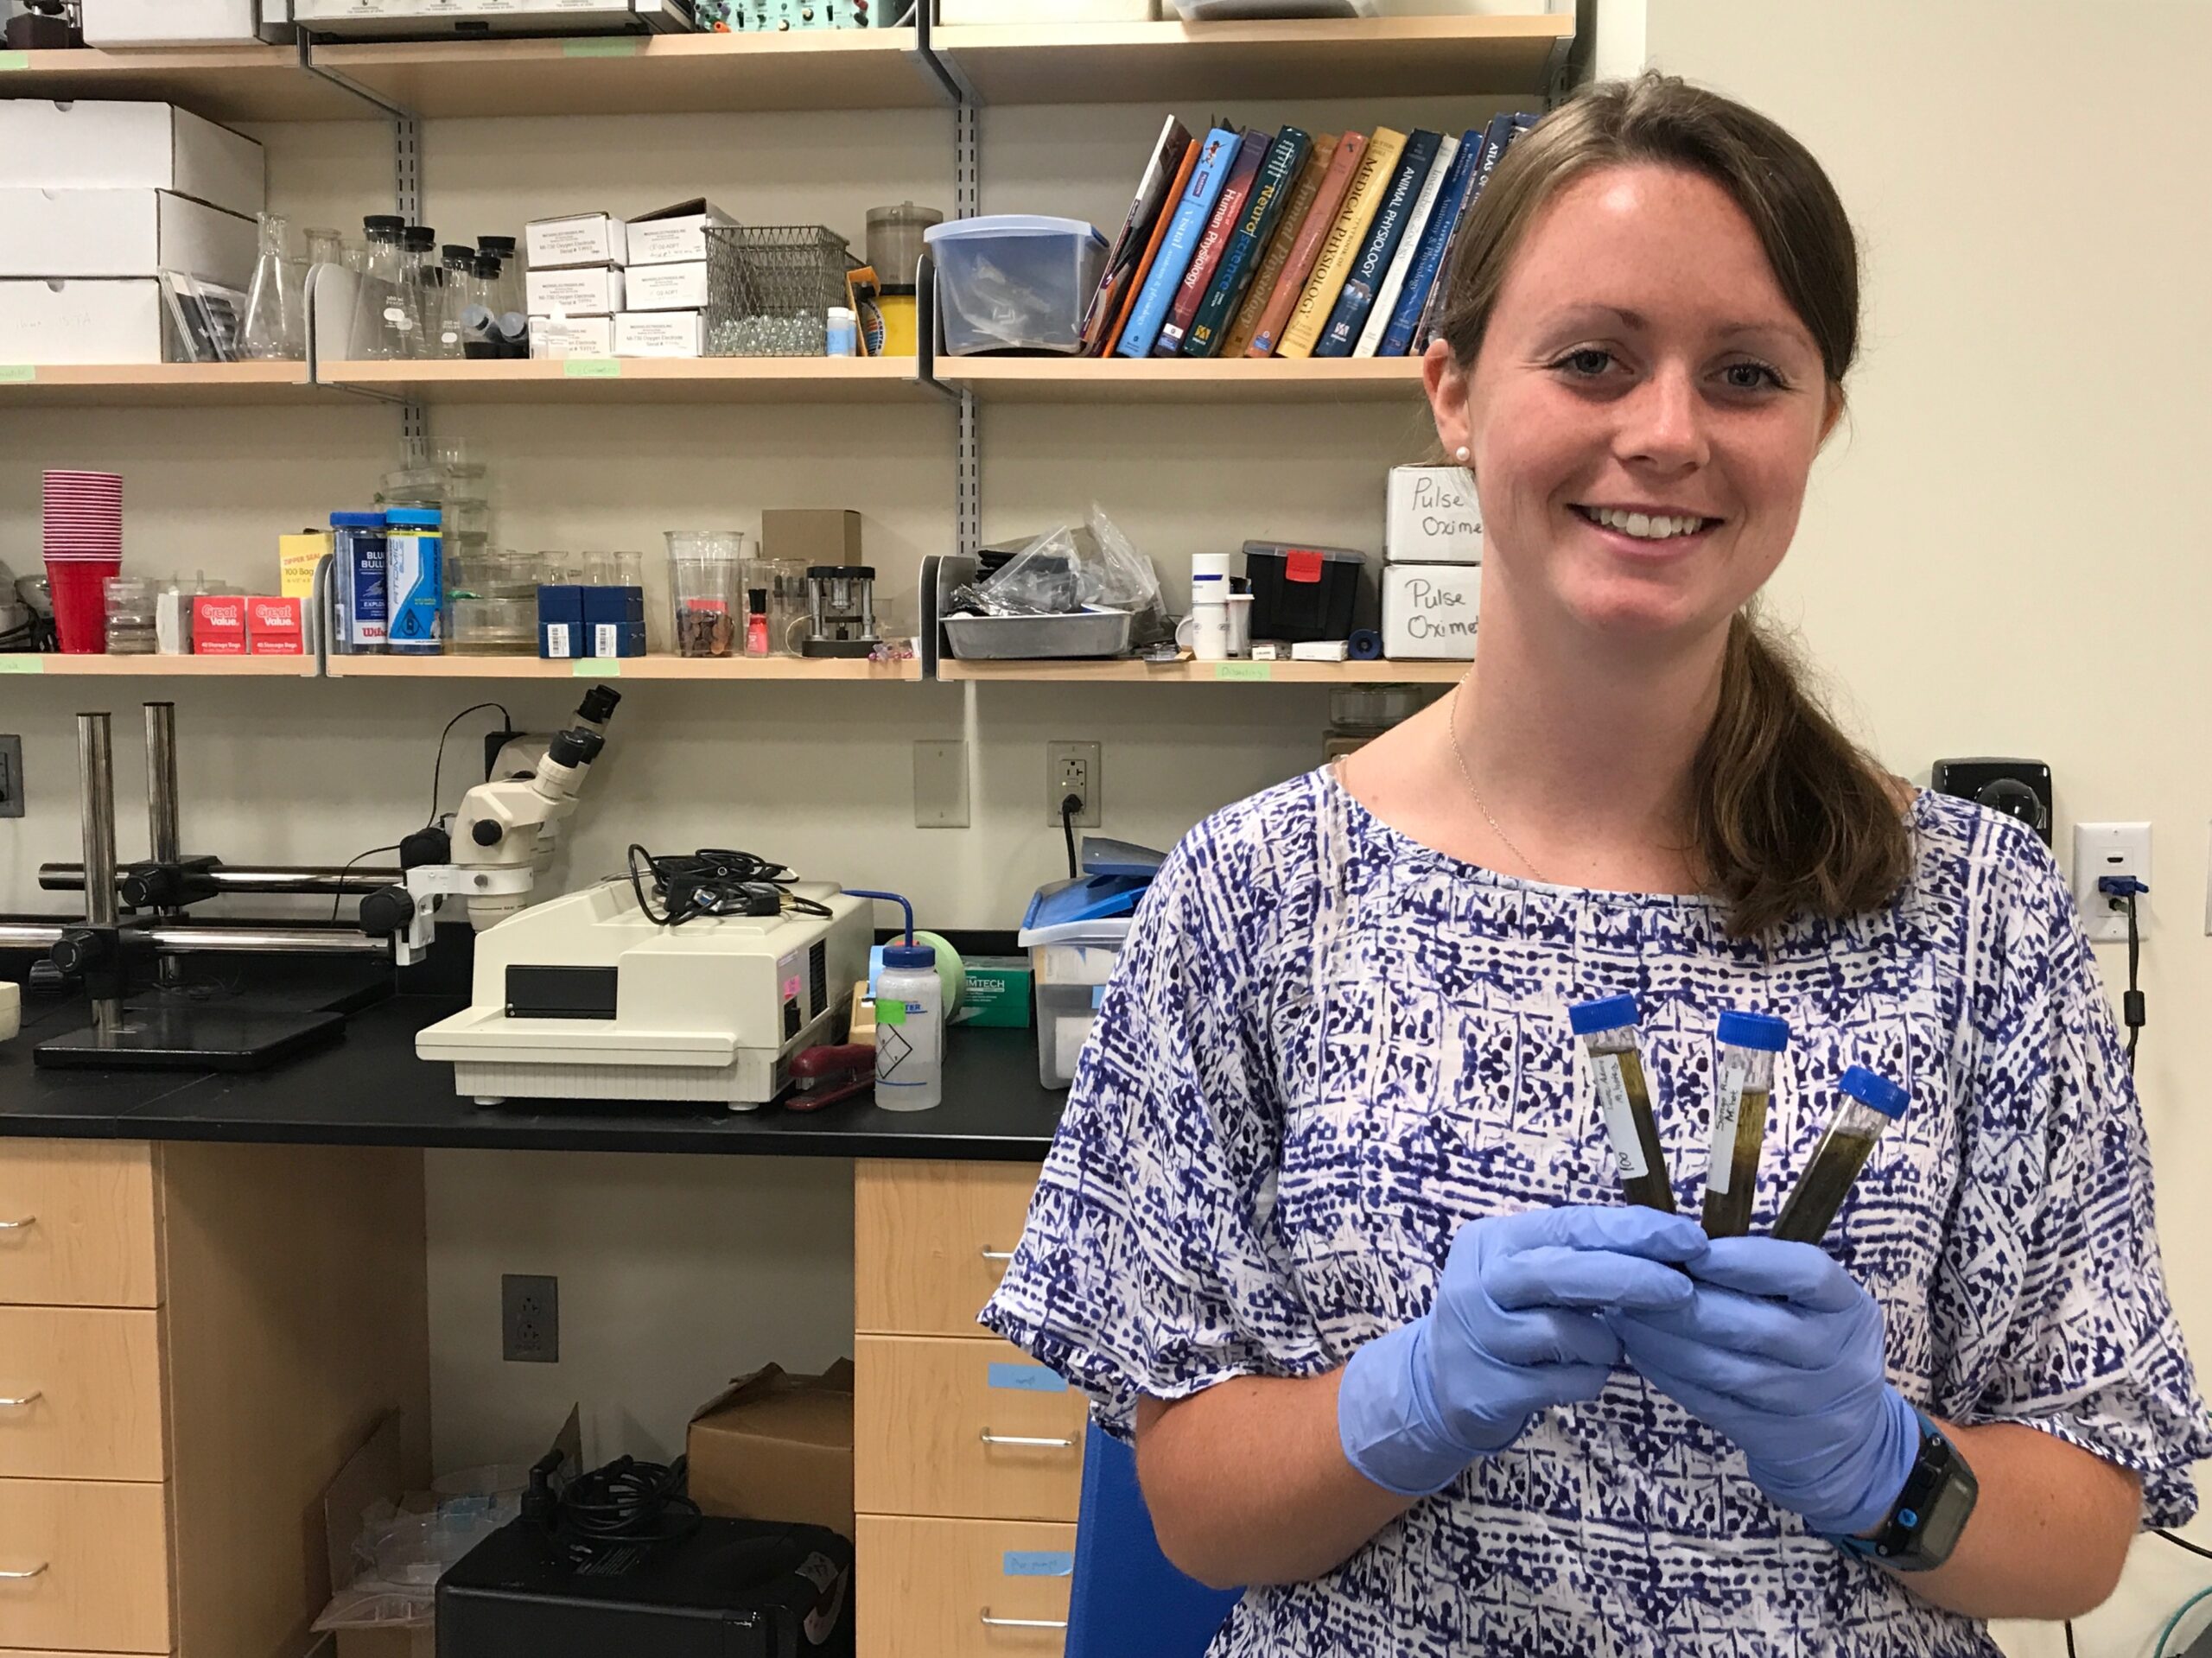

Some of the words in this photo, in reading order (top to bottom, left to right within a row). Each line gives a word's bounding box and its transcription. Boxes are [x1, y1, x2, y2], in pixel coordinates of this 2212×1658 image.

[1482, 142, 1499, 173] ATLAS
[1338, 156, 1377, 225] MEDICAL
[1389, 165, 1415, 211] ANIMAL
[1411, 168, 1443, 223] Invertebrate
[1210, 187, 1236, 230] Human
[1278, 175, 1319, 242] Animal
[1429, 194, 1453, 236] Anatomy
[1359, 208, 1398, 278] PHYSIOLOGY
[1394, 221, 1421, 263] Zoology
[1181, 229, 1218, 289] Physiology
[1296, 226, 1347, 319] PHYSIOLOGY
[1407, 245, 1434, 293] Physiology
[1236, 239, 1290, 330] Physiology
[1412, 477, 1464, 511] Pulse
[1422, 516, 1483, 537] Oxime
[360, 560, 385, 569] BULL
[365, 551, 385, 560] BLU
[284, 568, 298, 576] 100
[299, 568, 315, 577] Bag
[1404, 579, 1466, 608] Pulse
[201, 604, 238, 619] Great
[210, 617, 237, 626] Value
[256, 604, 292, 619] Great
[264, 617, 292, 626] Value
[1408, 615, 1479, 639] Oxime
[361, 627, 387, 638] Wils
[966, 979, 1006, 989] IMTECH
[1618, 1152, 1635, 1171] 100
